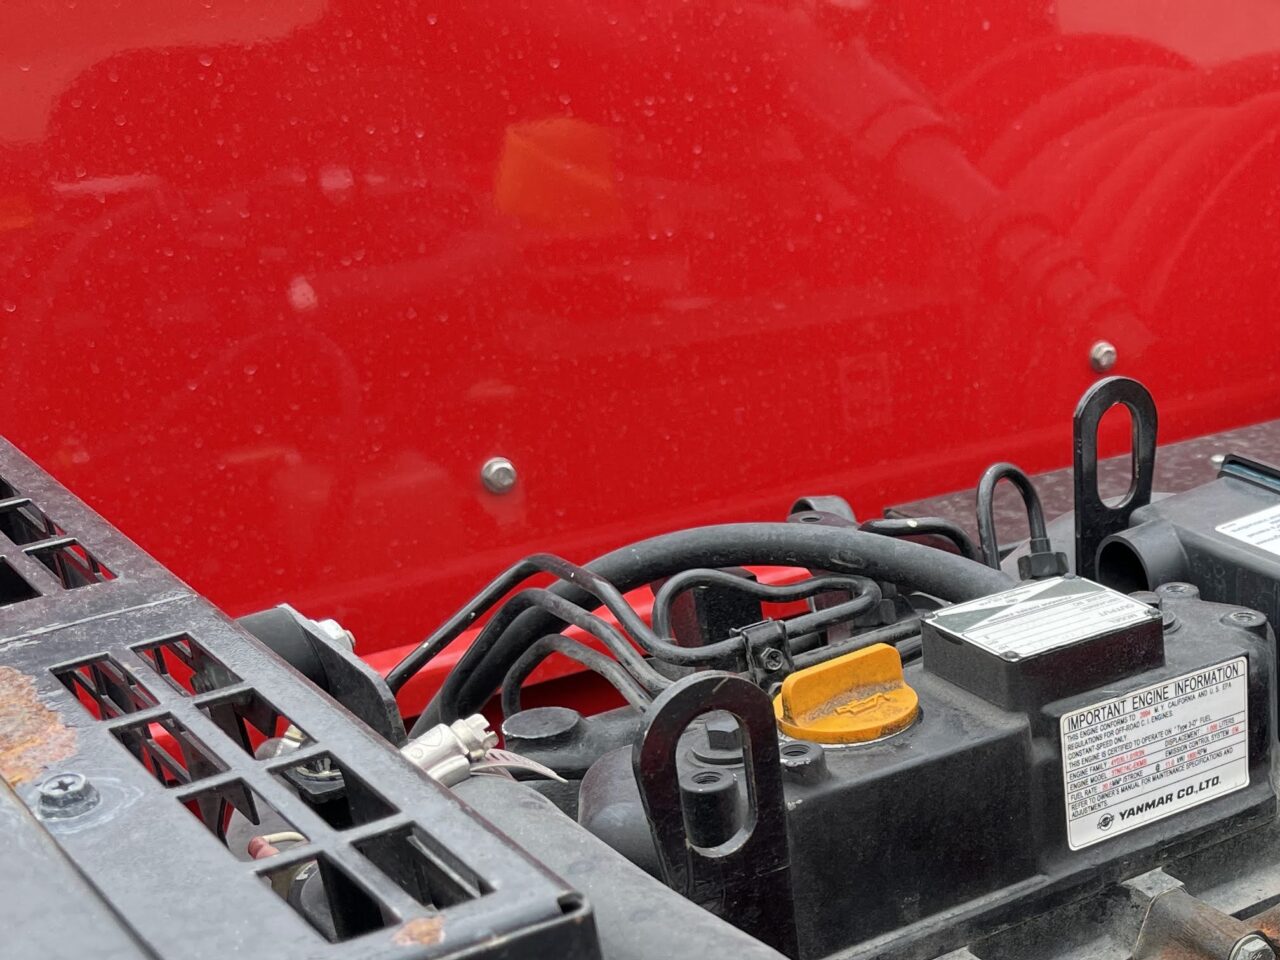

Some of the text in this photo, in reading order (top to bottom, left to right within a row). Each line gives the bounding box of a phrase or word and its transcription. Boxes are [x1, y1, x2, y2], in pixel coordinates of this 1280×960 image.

[1067, 661, 1238, 732] IMPORTANT ENGINE INFORMATION
[1067, 732, 1079, 742] THIS
[1079, 725, 1098, 738] ENGINE
[1099, 715, 1128, 732] CONFORMS
[1128, 713, 1136, 722] TO
[1167, 693, 1195, 709] CALIFORNIA
[1197, 688, 1207, 698] AND
[1221, 680, 1231, 690] EPA
[1067, 732, 1102, 751] REGULATIONS
[1103, 729, 1114, 739] FOR
[1114, 720, 1140, 735] OFF-ROAD
[1067, 738, 1113, 760] CONSTANT-SPEED
[1068, 758, 1080, 769] THIS
[1081, 751, 1100, 764] ENGINE
[1100, 749, 1106, 758] IS
[1107, 740, 1132, 756] CERTIFIED
[1133, 738, 1140, 746] TO
[1141, 730, 1164, 744] OPERATE
[1164, 727, 1172, 736] ON
[1164, 743, 1187, 757] EMISSION
[1188, 735, 1209, 749] CONTROL
[1210, 728, 1229, 741] SYSTEM
[1069, 767, 1088, 780] ENGINE
[1089, 760, 1107, 773] FAMILY
[1069, 777, 1089, 791] ENGINE
[1089, 771, 1107, 784] MODEL
[1070, 746, 1233, 811] REFER TO OWNER'S MANUAL FOR MAINTENANCE SPECIFICATIONS AND
[1070, 790, 1083, 802] FUEL
[1083, 785, 1097, 797] RATE
[1118, 792, 1173, 821] YANMAR
